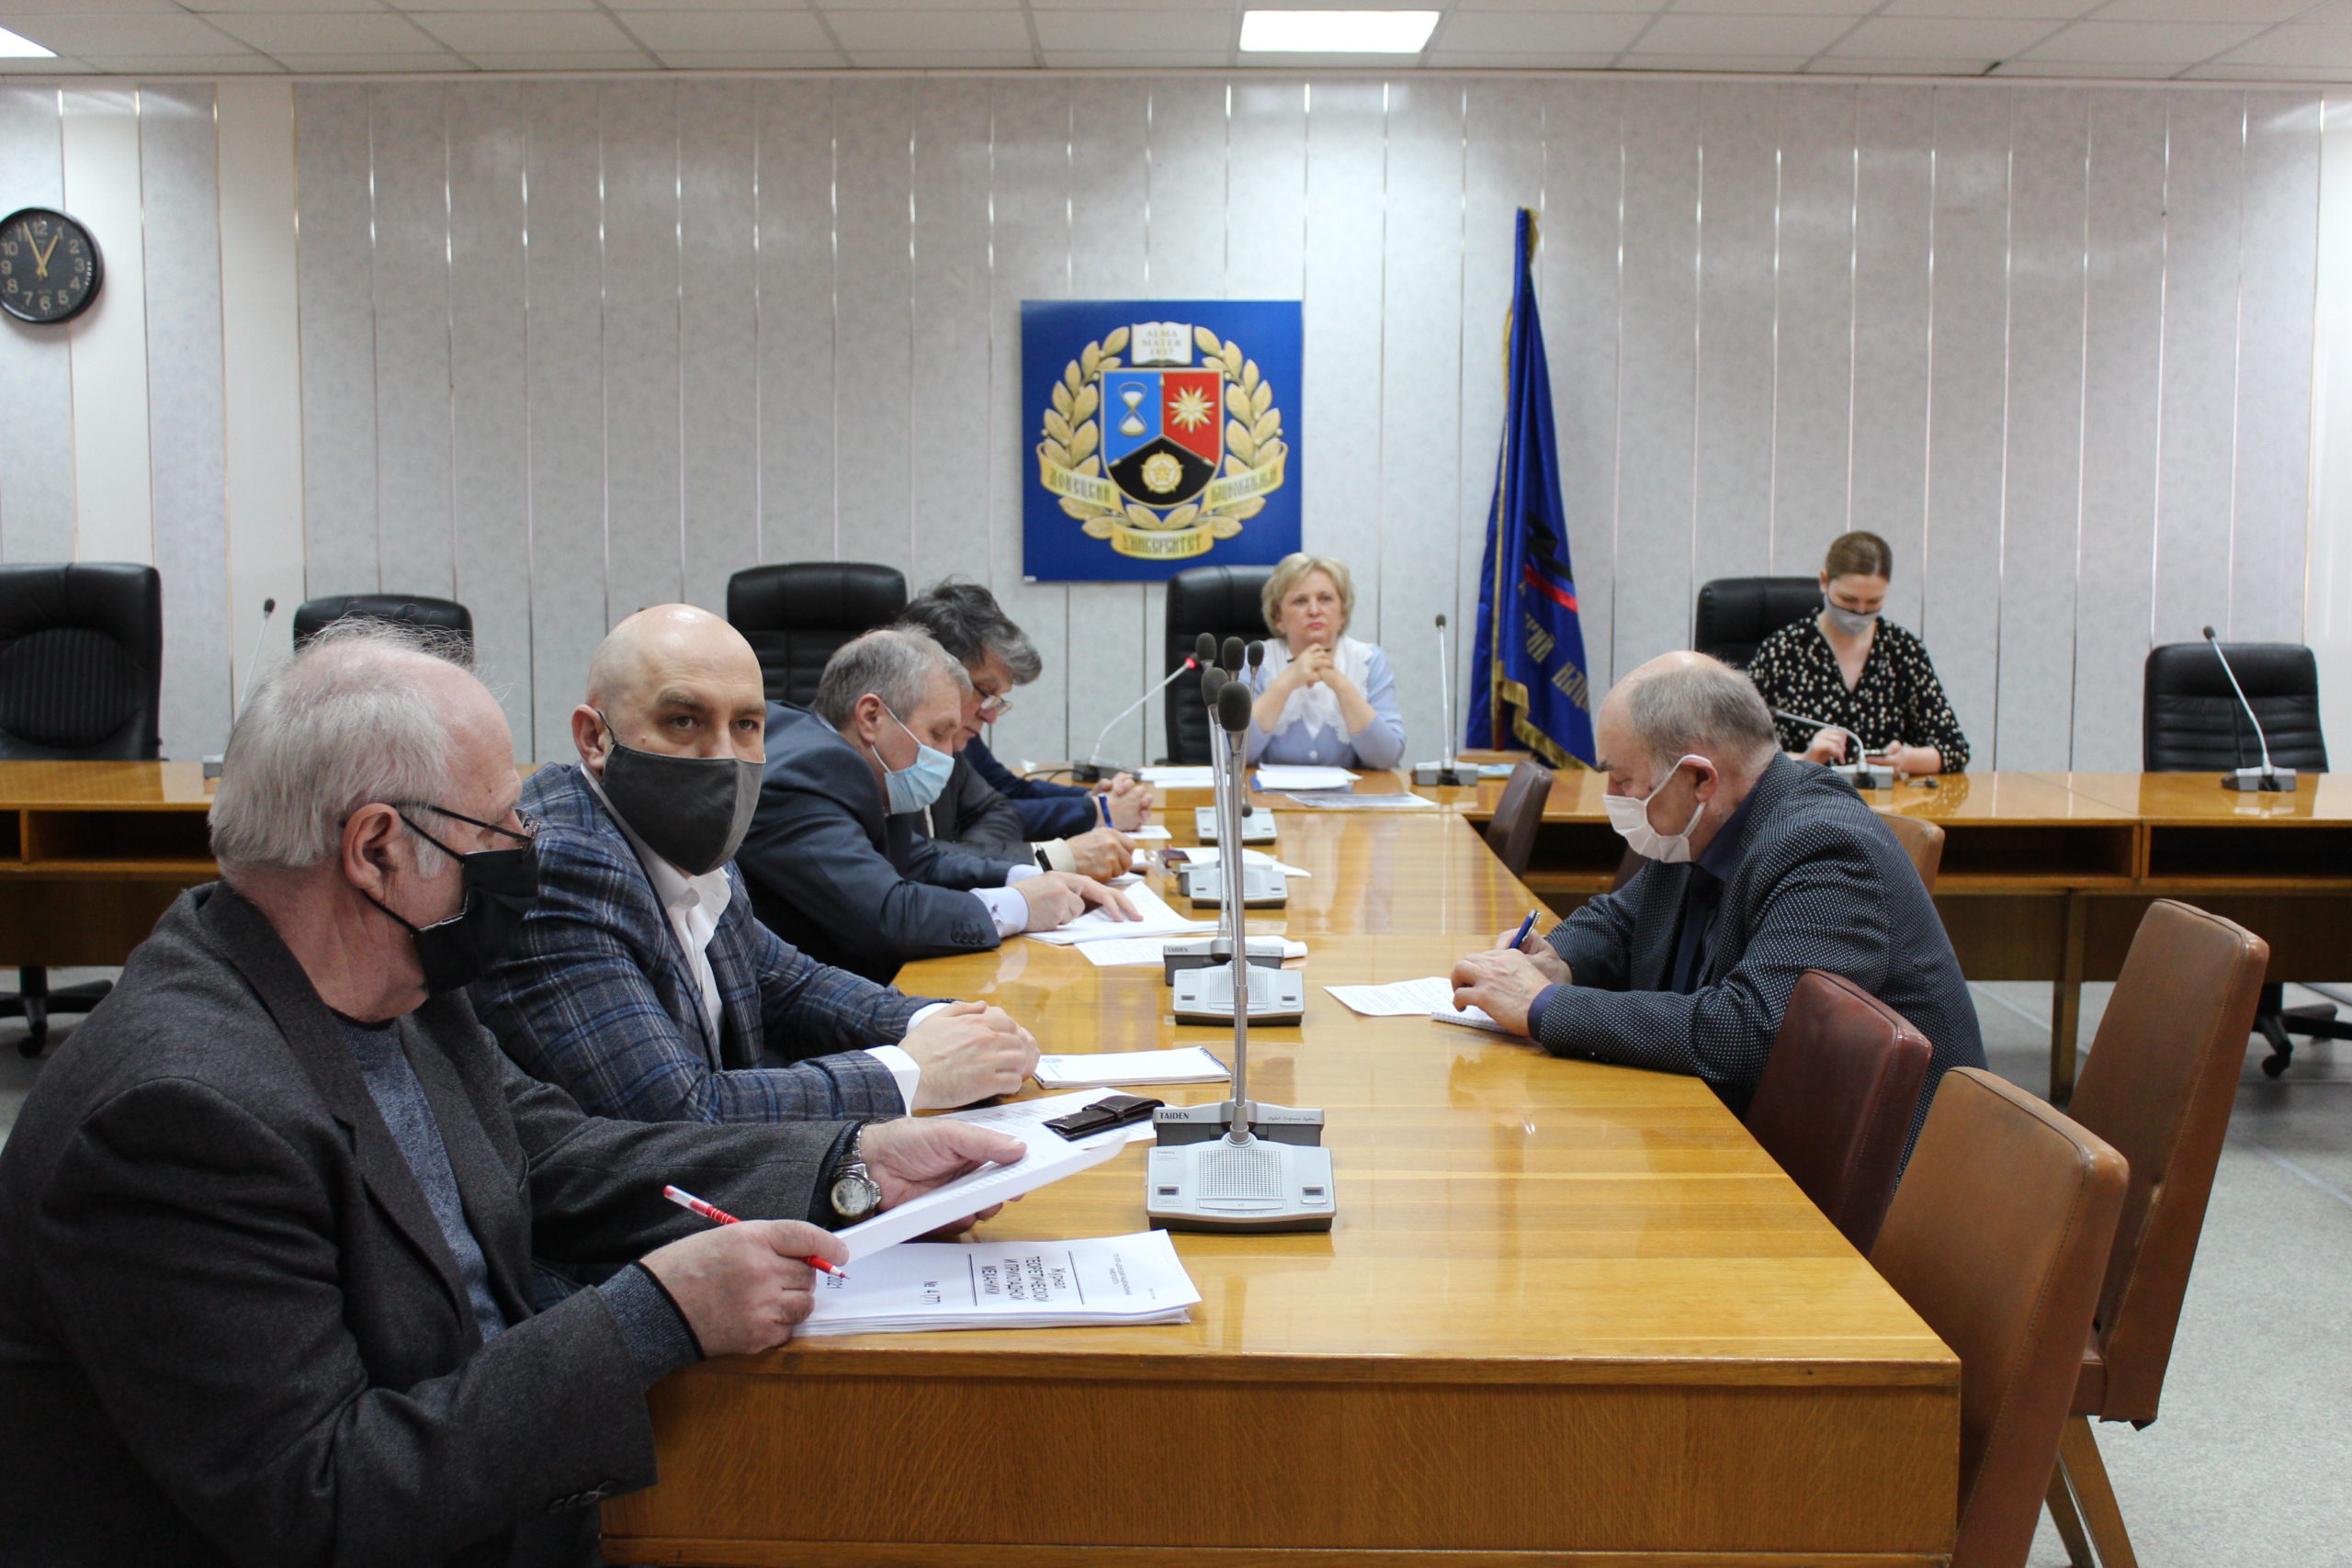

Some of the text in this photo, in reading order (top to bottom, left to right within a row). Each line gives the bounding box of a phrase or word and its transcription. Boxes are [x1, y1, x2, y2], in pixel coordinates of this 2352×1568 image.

[33, 220, 48, 235] 12
[56, 226, 63, 240] 1
[1, 242, 18, 255] 10
[69, 239, 80, 254] 2
[1, 260, 11, 275] 9
[74, 257, 85, 272] 3
[7, 278, 18, 293] 8
[70, 276, 80, 290] 4
[23, 290, 33, 306] 7
[40, 295, 51, 310] 6
[58, 289, 69, 304] 5
[1147, 329, 1178, 337] ALMA
[1142, 338, 1182, 346] MATER
[981, 1265, 1001, 1294] МЕХАНИКИ
[1025, 1256, 1053, 1302] ТЕОРЕТИЧЕСКОЙ
